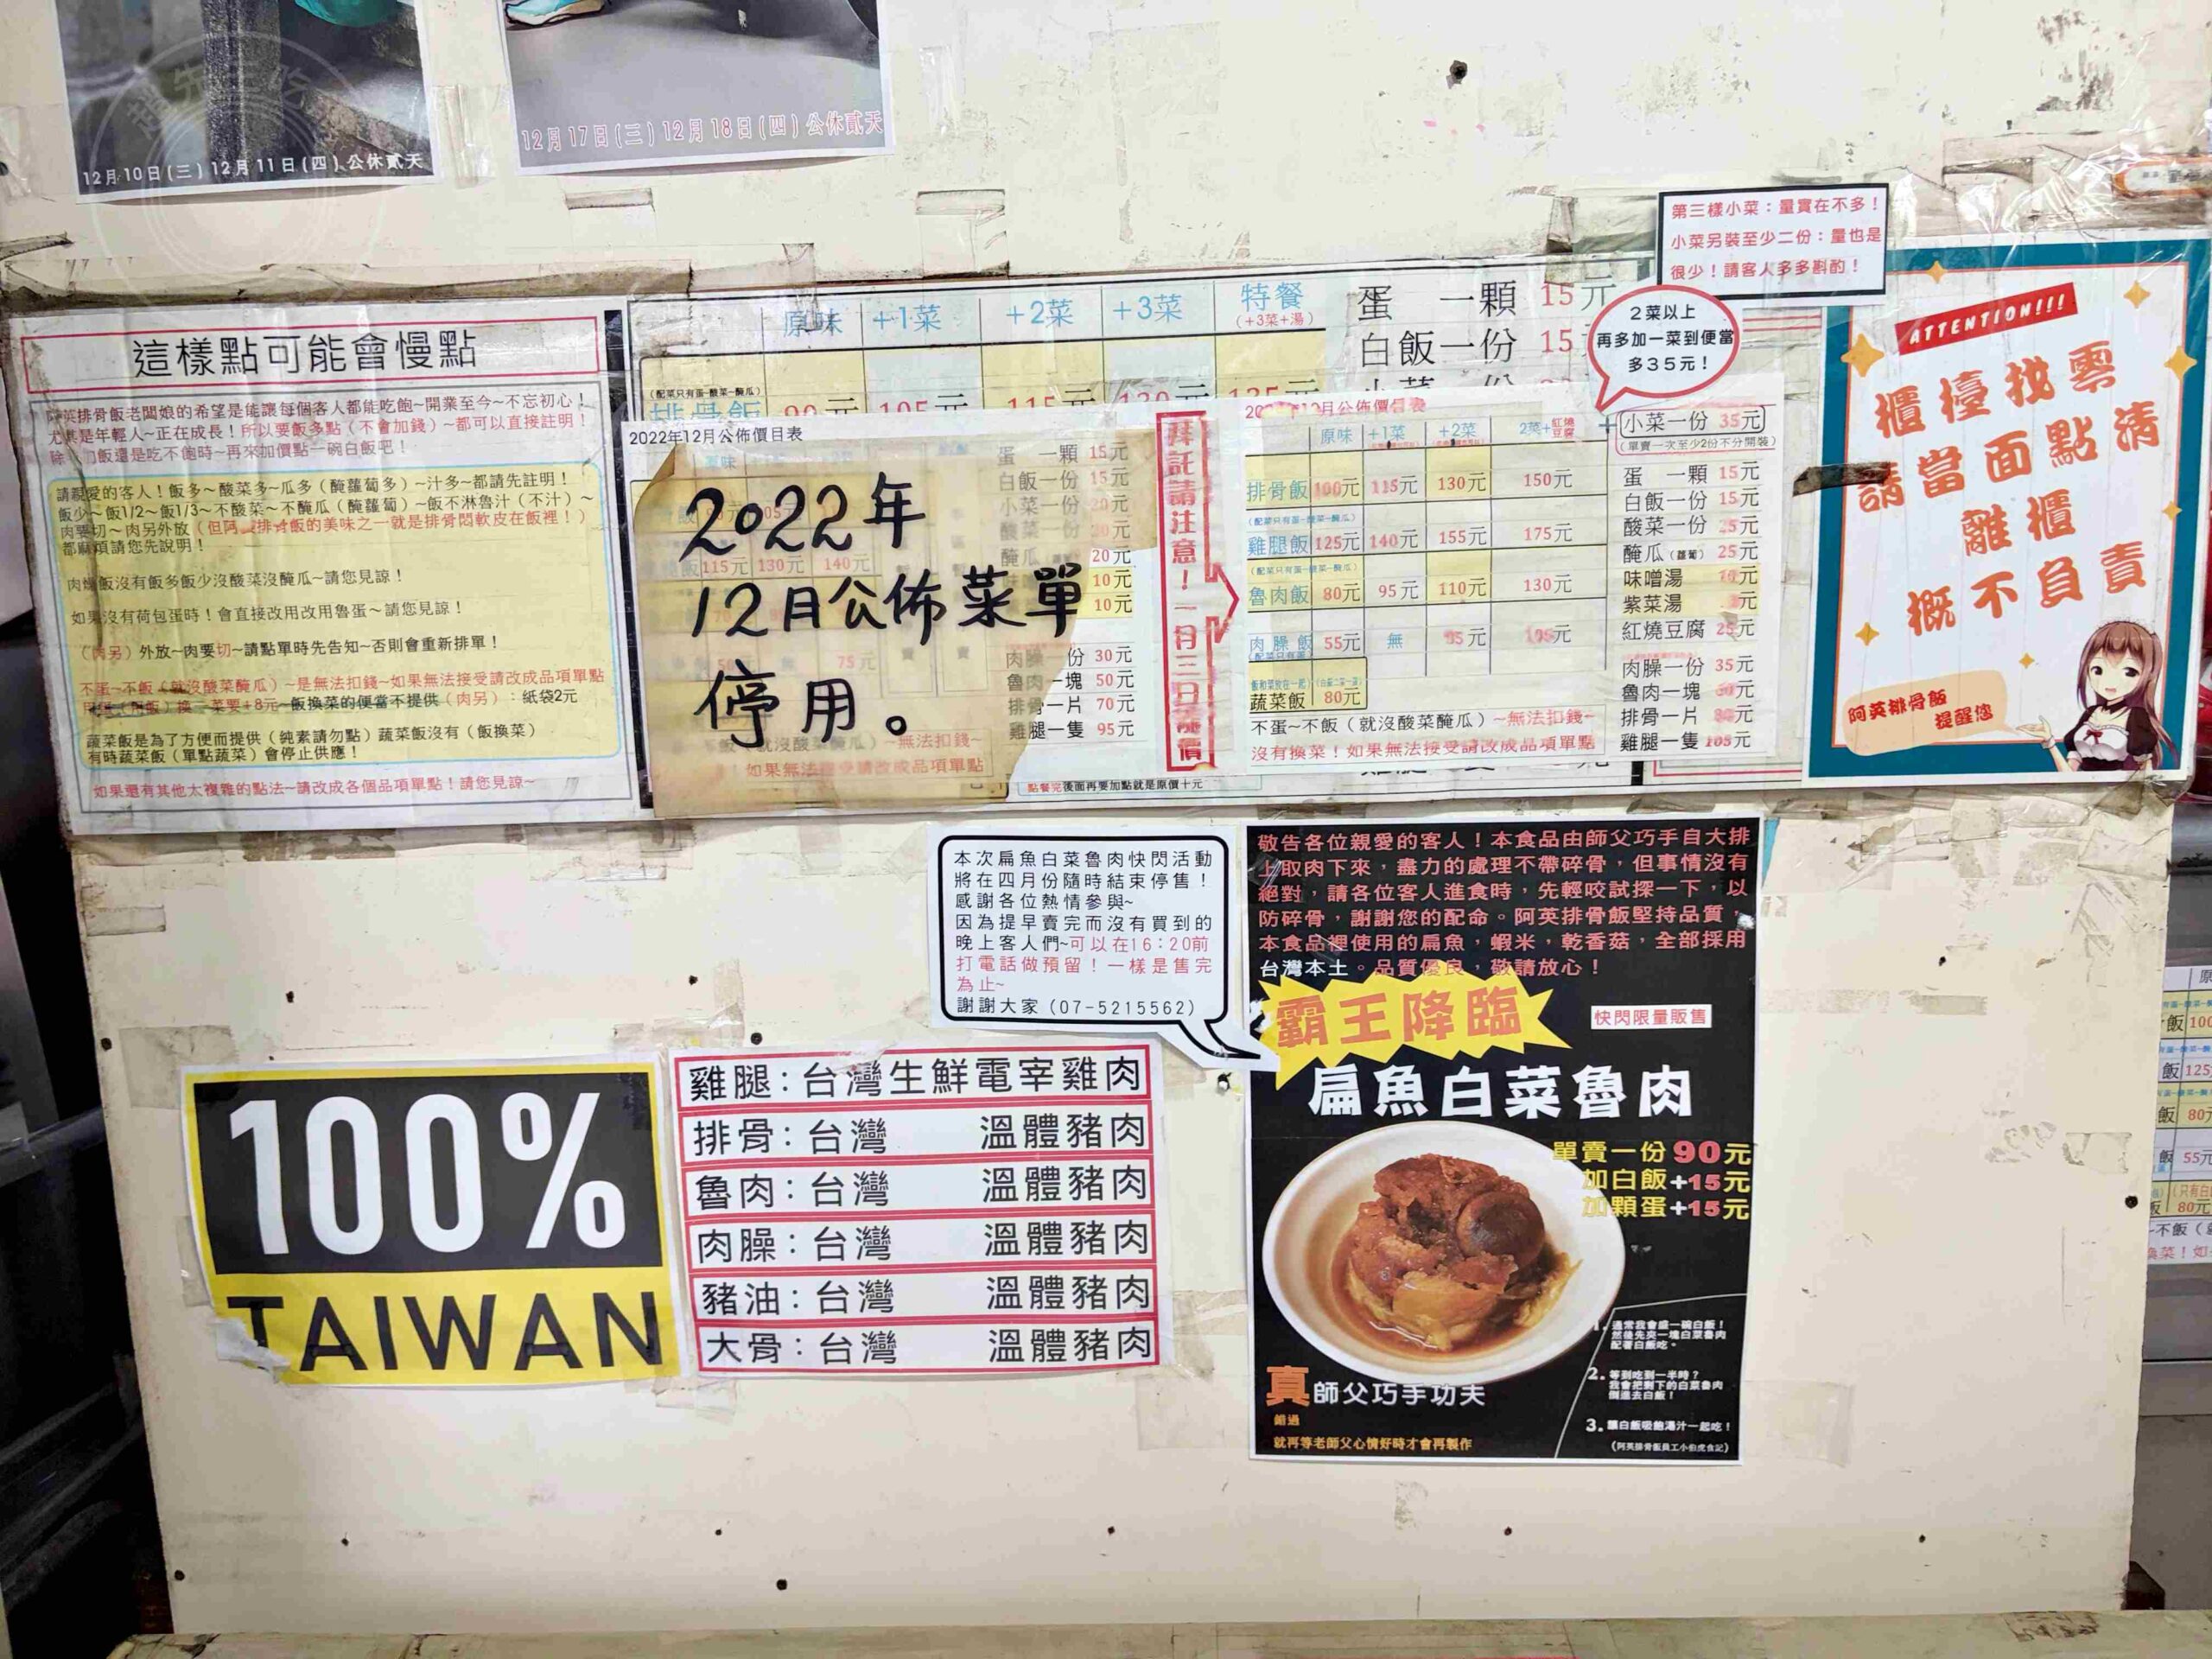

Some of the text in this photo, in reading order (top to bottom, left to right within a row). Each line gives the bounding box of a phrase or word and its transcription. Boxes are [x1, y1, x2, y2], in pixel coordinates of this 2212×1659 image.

[804, 109, 883, 137] 公休貳天
[1671, 196, 1878, 220] 第三樣小菜：量實在不多！
[1671, 226, 1882, 251] 小菜另裝至少二份：量也是
[1670, 258, 1859, 281] 很少！請客人多多斟酌！
[784, 280, 1304, 339] 原味 +1菜 +2菜 +3菜 特餐
[1357, 279, 1517, 322] 蛋 一顆
[1629, 303, 1696, 322] 2菜以上
[1908, 292, 2067, 346] ATTENTION!!!
[1360, 326, 1518, 369] 白飯一份
[1596, 328, 1735, 349] 再多加一菜到便當
[132, 328, 478, 379] 這樣點可能會慢點
[1627, 355, 1709, 373] 多35元！
[1320, 428, 1353, 445] 原味
[1367, 424, 1407, 442] +1菜
[1439, 423, 1477, 438] +2菜
[1623, 409, 1761, 434] 小菜一份 35元
[629, 425, 804, 445] 2022年12月公佈價目表
[1856, 400, 2160, 513] 請當面點清
[999, 469, 1080, 493] 白飯一份
[1246, 480, 1308, 502] 排骨飯
[1438, 472, 1487, 493] 130元
[1523, 468, 1573, 489] 150元
[1623, 461, 1760, 487] 蛋 一顆 15元
[1624, 486, 1760, 512] 白飯一份 15元
[679, 471, 926, 563] 2022年
[1623, 514, 1707, 537] 酸菜一份
[1960, 487, 2077, 556] 離櫃
[1247, 523, 1573, 556] 雞腿飯 125元 140元 155元 175元
[1717, 541, 1759, 562] 25元
[1092, 569, 1133, 590] 10元
[1249, 574, 1573, 607] 魯肉飯 80元 95元 110元 130元
[1623, 568, 1684, 588] 味噌湯
[1906, 540, 2147, 637] 概不負責
[690, 562, 1084, 646] 12月公佈菜單
[1094, 594, 1133, 614] 10元
[1622, 593, 1682, 614] 紫菜湯
[1249, 632, 1404, 652] 肉臊飯 55元 無
[1621, 620, 1706, 641] 紅燒豆腐
[1094, 645, 1133, 665] 30元
[1621, 657, 1706, 679] 肉臊一份
[1714, 655, 1755, 674] 35元
[1096, 670, 1135, 690] 50元
[1620, 681, 1701, 703] 魯肉一塊
[692, 659, 908, 748] 停用。
[1096, 694, 1135, 714] 70元
[1249, 687, 1362, 712] 蔬菜飯 80元
[1847, 688, 1948, 725] 阿英排骨飯
[1096, 718, 1135, 739] 95元
[1620, 705, 1699, 728] 排骨一片
[1933, 702, 1994, 731] 提醒您
[1619, 731, 1700, 753] 雞腿一隻
[1257, 827, 1751, 853] 敬告各位親愛的客人！本食品由師父巧手自大排
[953, 849, 1213, 868] 本次扁魚白菜魯肉快閃活動
[1257, 852, 1750, 878] 上取肉下來，盡力的處理不帶碎骨，但事情沒有
[954, 871, 1209, 890] 將在四月份隨時結束停售！
[1257, 878, 1749, 905] 絕對，請各位客人進食時，先輕咬試探一下，以
[955, 893, 1135, 912] 感謝各位熱情參與~
[955, 913, 1213, 932] 因為提早賣完而沒有買到的
[1258, 930, 1747, 953] 本食品裡使用的扁魚，蝦米，乾香菇，全部採用
[955, 955, 1213, 975] 打電話做預留！一樣是售完
[956, 975, 1006, 994] 為止~
[1275, 985, 1523, 1049] 霸王降臨
[1593, 1007, 1708, 1027] 快閃限量販售
[688, 1054, 1141, 1103] 雞腿：台灣生鮮電宰雞肉
[1306, 1063, 1694, 1120] 扁魚白菜魯肉
[693, 1111, 1147, 1158] 排骨：台灣 溫體豬肉
[229, 1091, 626, 1255] 100%
[1582, 1167, 1751, 1193] 加白飯+15元
[695, 1163, 1148, 1211] 魯肉：台灣 溫體豬肉
[697, 1218, 1150, 1265] 肉臊：台灣 溫體豬肉
[702, 1272, 1151, 1319] 豬油：台灣 溫體豬肉
[226, 1290, 664, 1372] TAIWAN
[705, 1325, 1153, 1367] 大骨：台灣 溫體豬肉
[1586, 1367, 1606, 1381] 2.
[1586, 1418, 1605, 1433] 3.
[1273, 1436, 1473, 1452] 就再等老師父心情好時才會再製作
